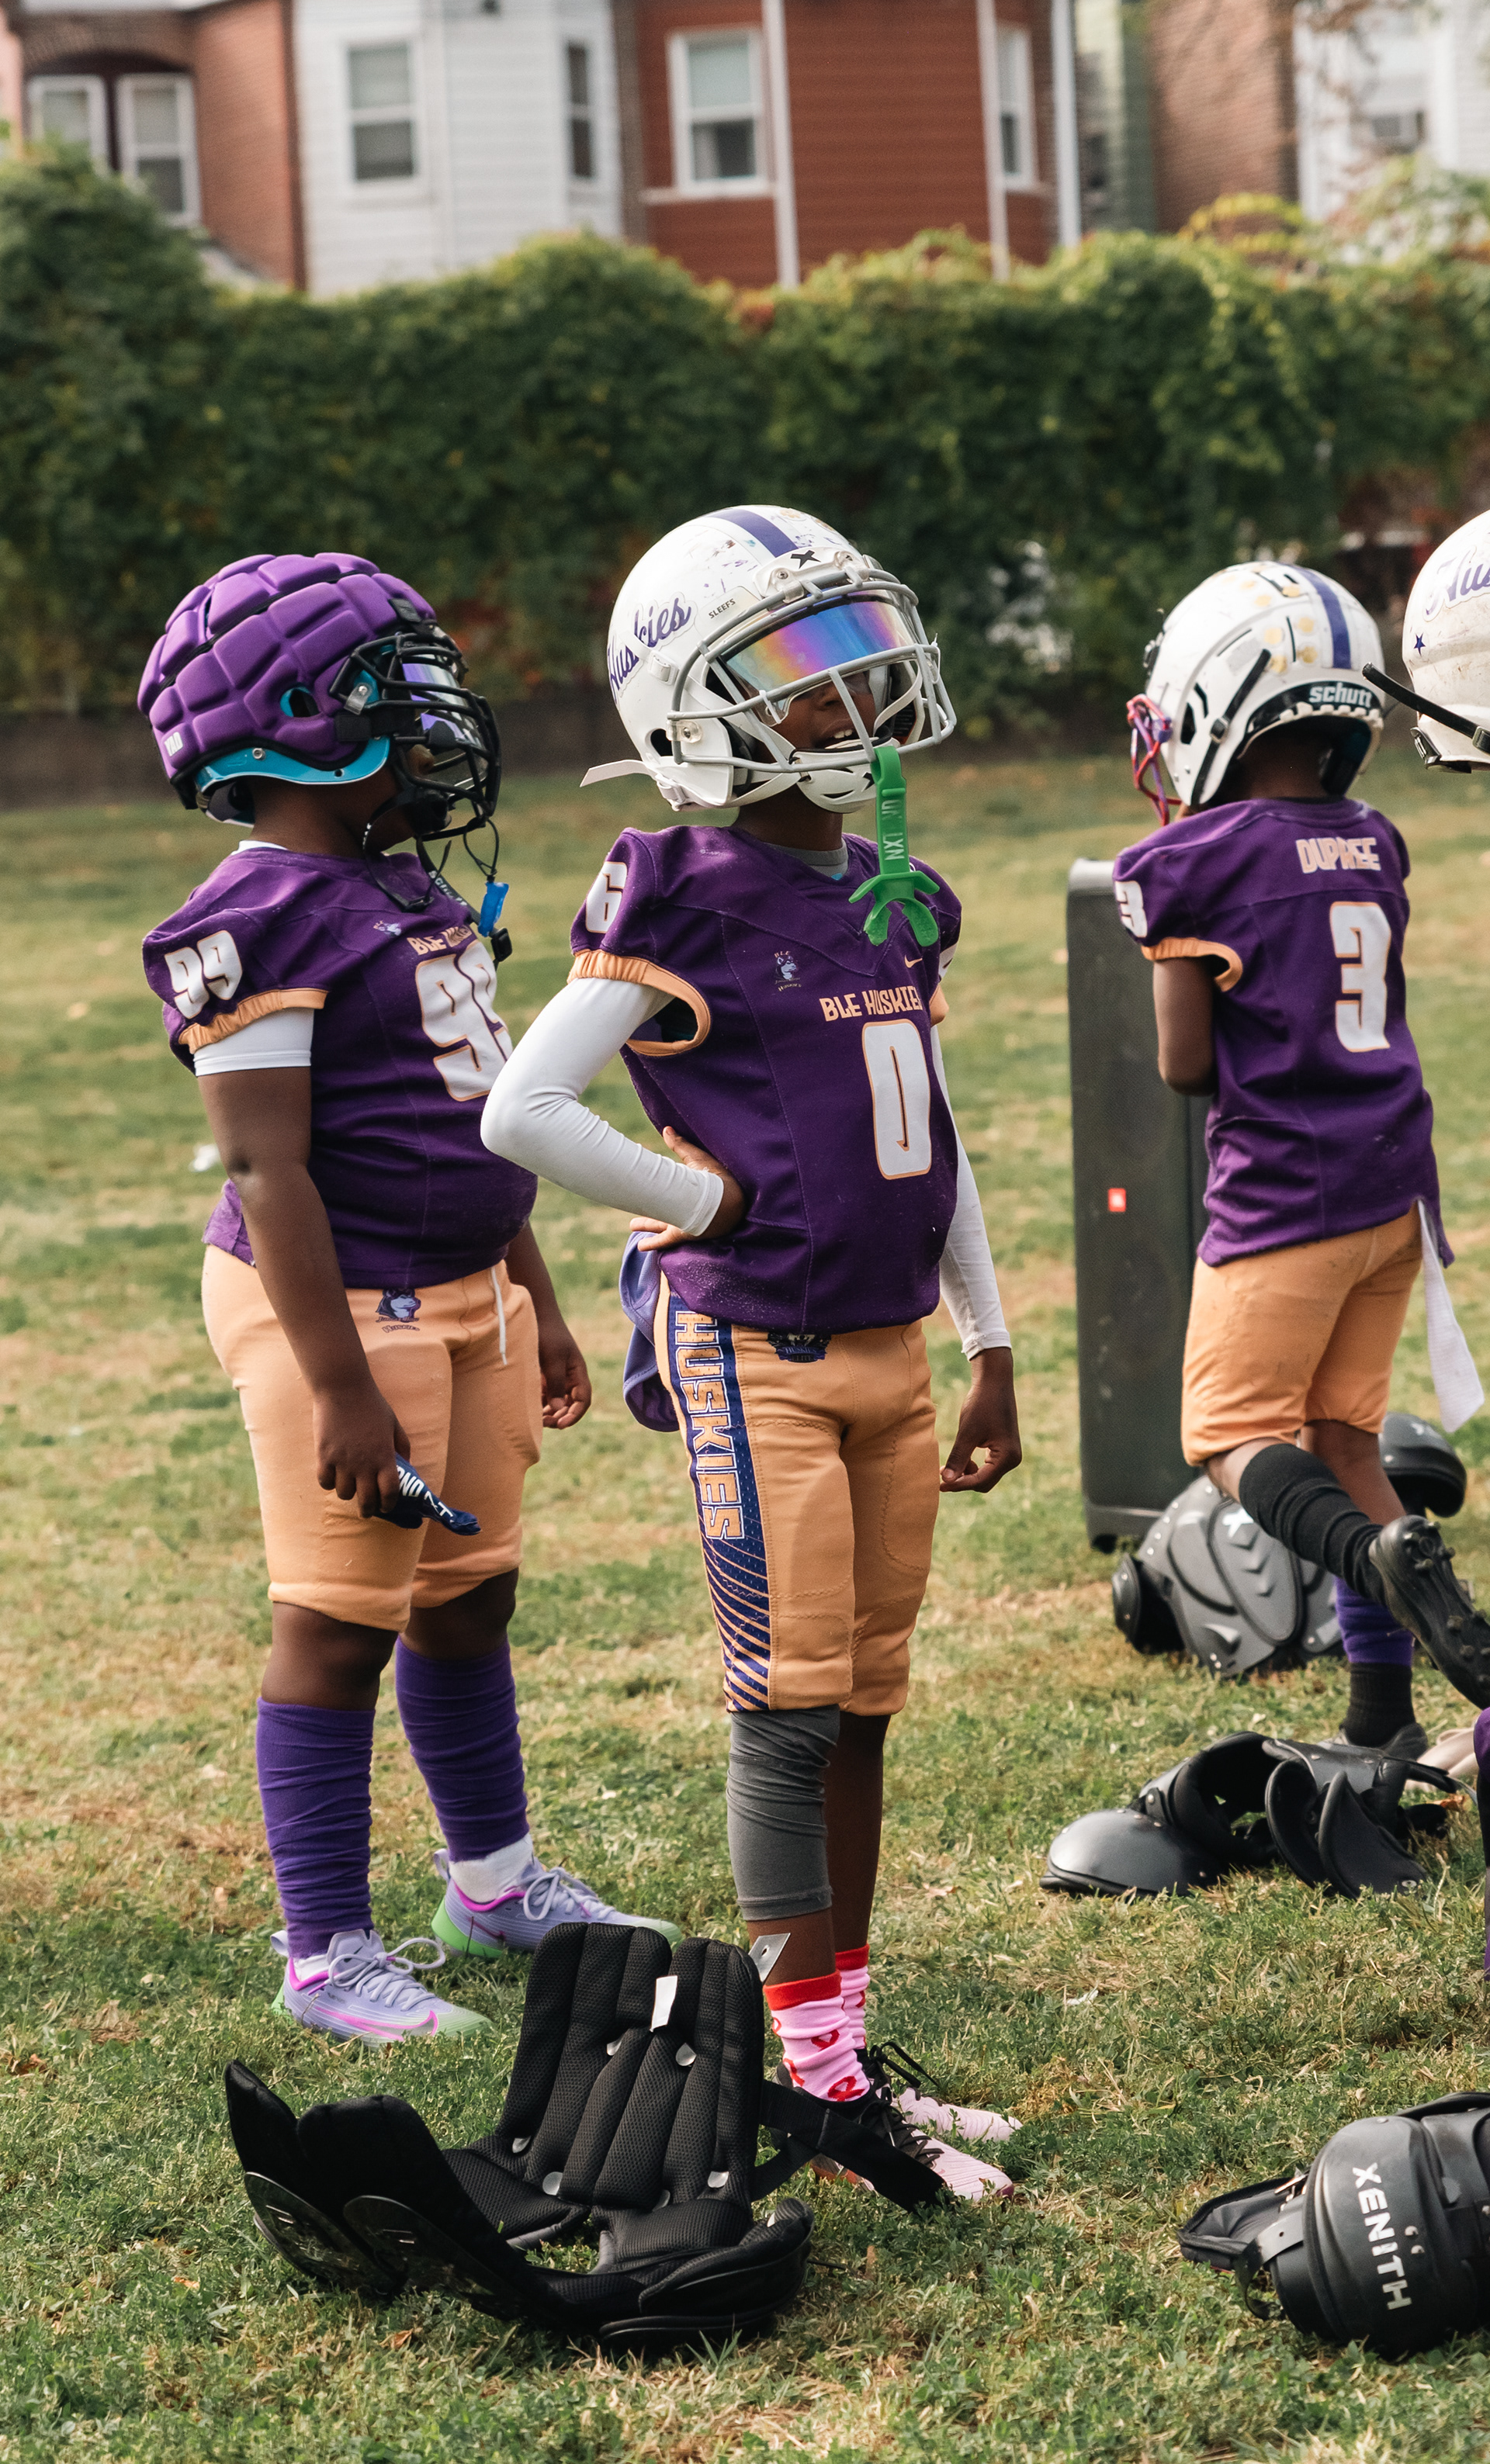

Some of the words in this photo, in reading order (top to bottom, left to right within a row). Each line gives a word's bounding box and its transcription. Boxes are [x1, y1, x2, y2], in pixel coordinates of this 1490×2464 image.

[708, 598, 736, 619] SLEEFS
[1426, 550, 1490, 615] Hu
[1114, 881, 1149, 938] 3
[164, 929, 243, 1019] 99
[819, 993, 863, 1022] BLE
[861, 985, 923, 1016] HUSKIE
[1329, 901, 1391, 1053] 3
[861, 1018, 932, 1181] 0
[674, 1310, 745, 1540] HUSKIES
[1352, 2162, 1412, 2310] XENITH
